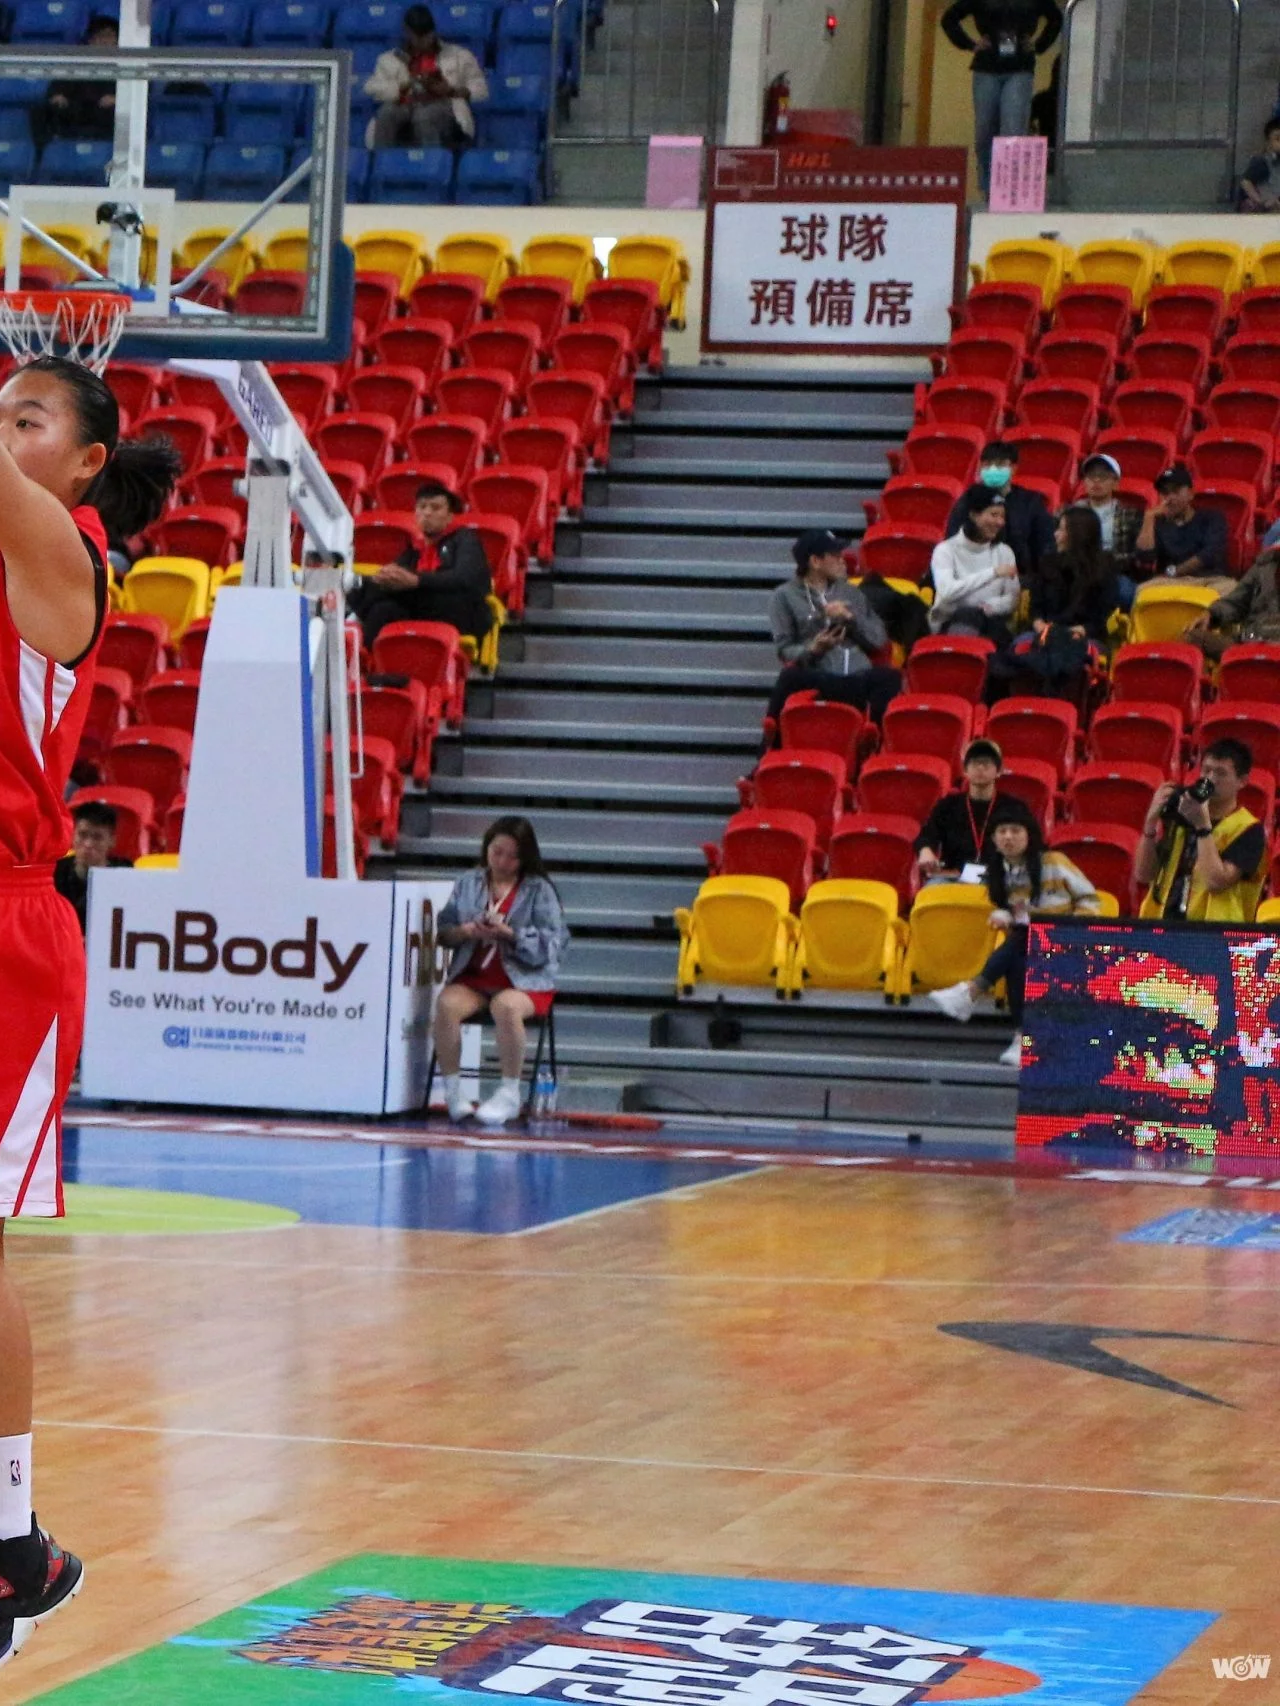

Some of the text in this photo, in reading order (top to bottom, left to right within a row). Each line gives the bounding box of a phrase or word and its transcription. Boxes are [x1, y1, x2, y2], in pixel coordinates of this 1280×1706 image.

[780, 213, 888, 262] 球隊
[749, 278, 914, 328] 預備席
[108, 906, 370, 994] InBody
[108, 989, 366, 1020] See What You're Made of
